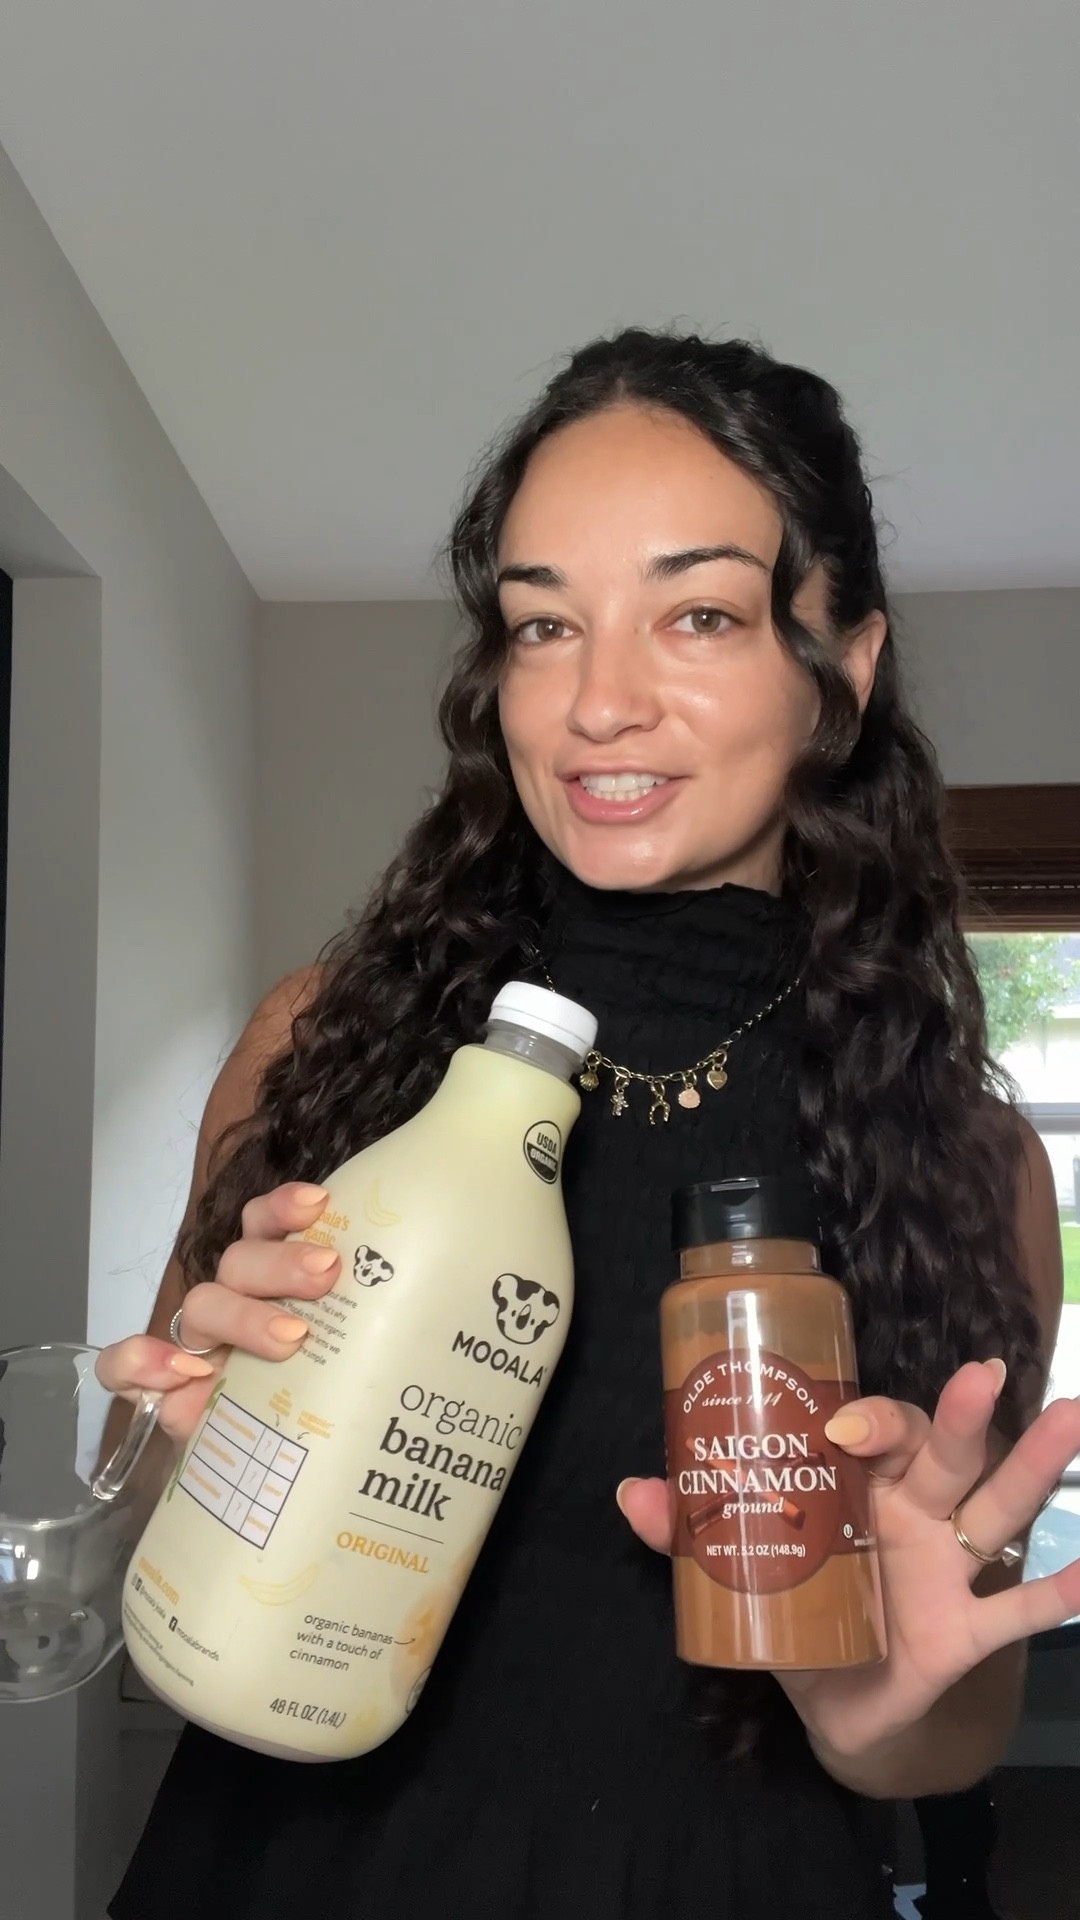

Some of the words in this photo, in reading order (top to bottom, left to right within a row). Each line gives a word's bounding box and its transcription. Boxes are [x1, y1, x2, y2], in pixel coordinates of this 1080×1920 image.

[536, 1132, 557, 1154] USDA
[324, 1323, 347, 1340] organic
[329, 1344, 341, 1355] we
[452, 1330, 544, 1388] MOOALA
[683, 1370, 715, 1414] OLDE
[701, 1393, 742, 1407] since
[400, 1384, 523, 1450] organic
[379, 1416, 508, 1491] banana
[693, 1433, 809, 1462] SAIGON
[678, 1466, 838, 1495] CINNAMON
[358, 1469, 452, 1522] milk
[721, 1496, 785, 1520] ground
[336, 1531, 430, 1575] ORIGINAL
[706, 1545, 722, 1557] NET
[723, 1545, 740, 1557] WT.
[741, 1545, 755, 1557] 5.2
[755, 1545, 770, 1557] OZ
[770, 1544, 806, 1559] (148.9g)
[303, 1614, 351, 1635] organic
[350, 1624, 394, 1645] bananas
[296, 1631, 324, 1647] with
[326, 1638, 334, 1649] a
[336, 1640, 369, 1657] touch
[369, 1648, 384, 1660] of
[289, 1649, 350, 1672] cinnamon
[269, 1698, 287, 1714] 48
[286, 1701, 300, 1718] FL
[300, 1704, 318, 1722] OZ
